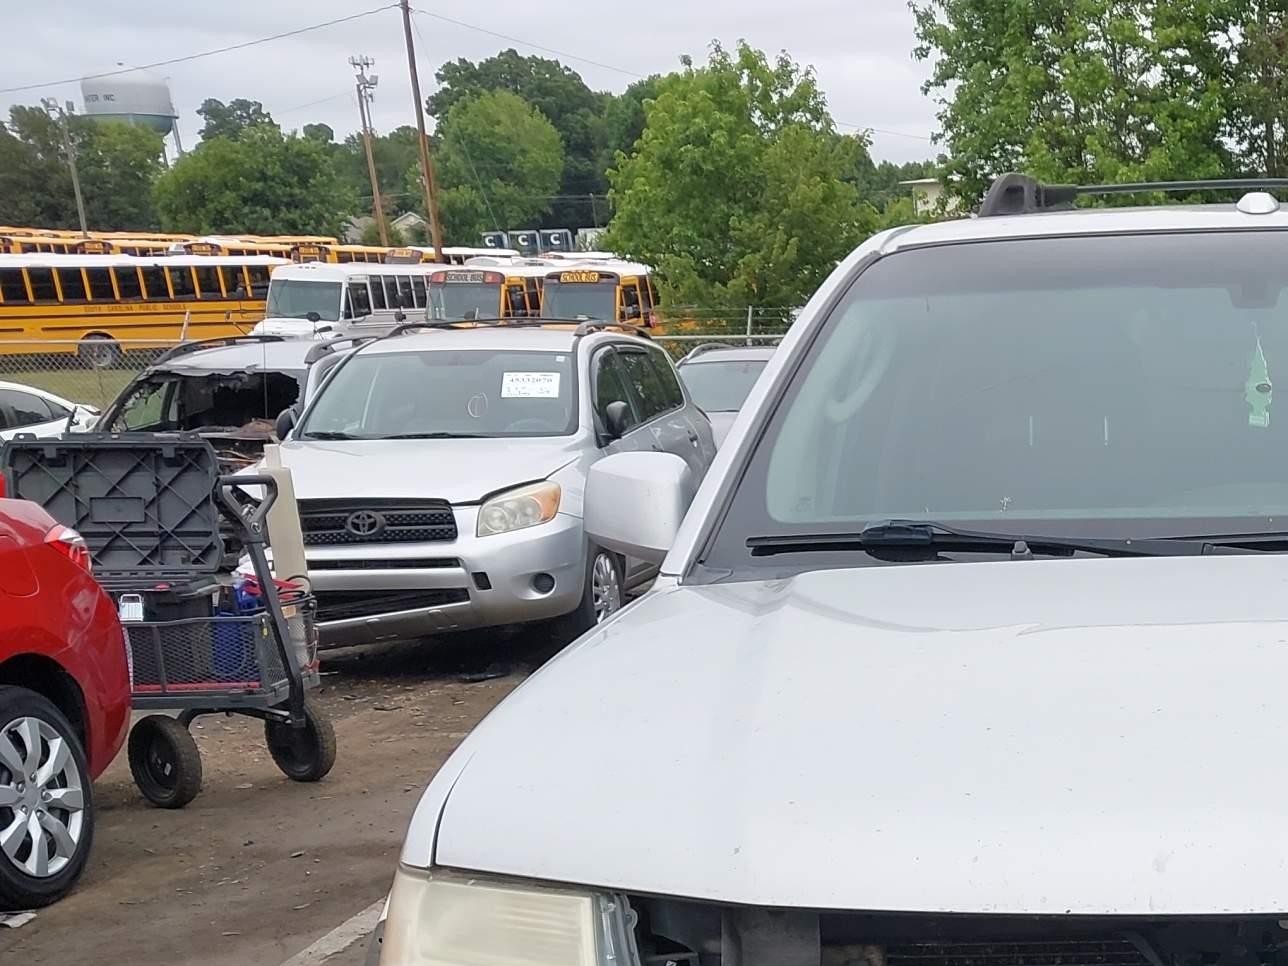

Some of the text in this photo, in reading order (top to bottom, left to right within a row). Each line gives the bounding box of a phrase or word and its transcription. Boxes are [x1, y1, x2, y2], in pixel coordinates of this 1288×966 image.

[484, 236, 496, 247] C
[518, 235, 528, 246] C
[550, 233, 561, 245] C
